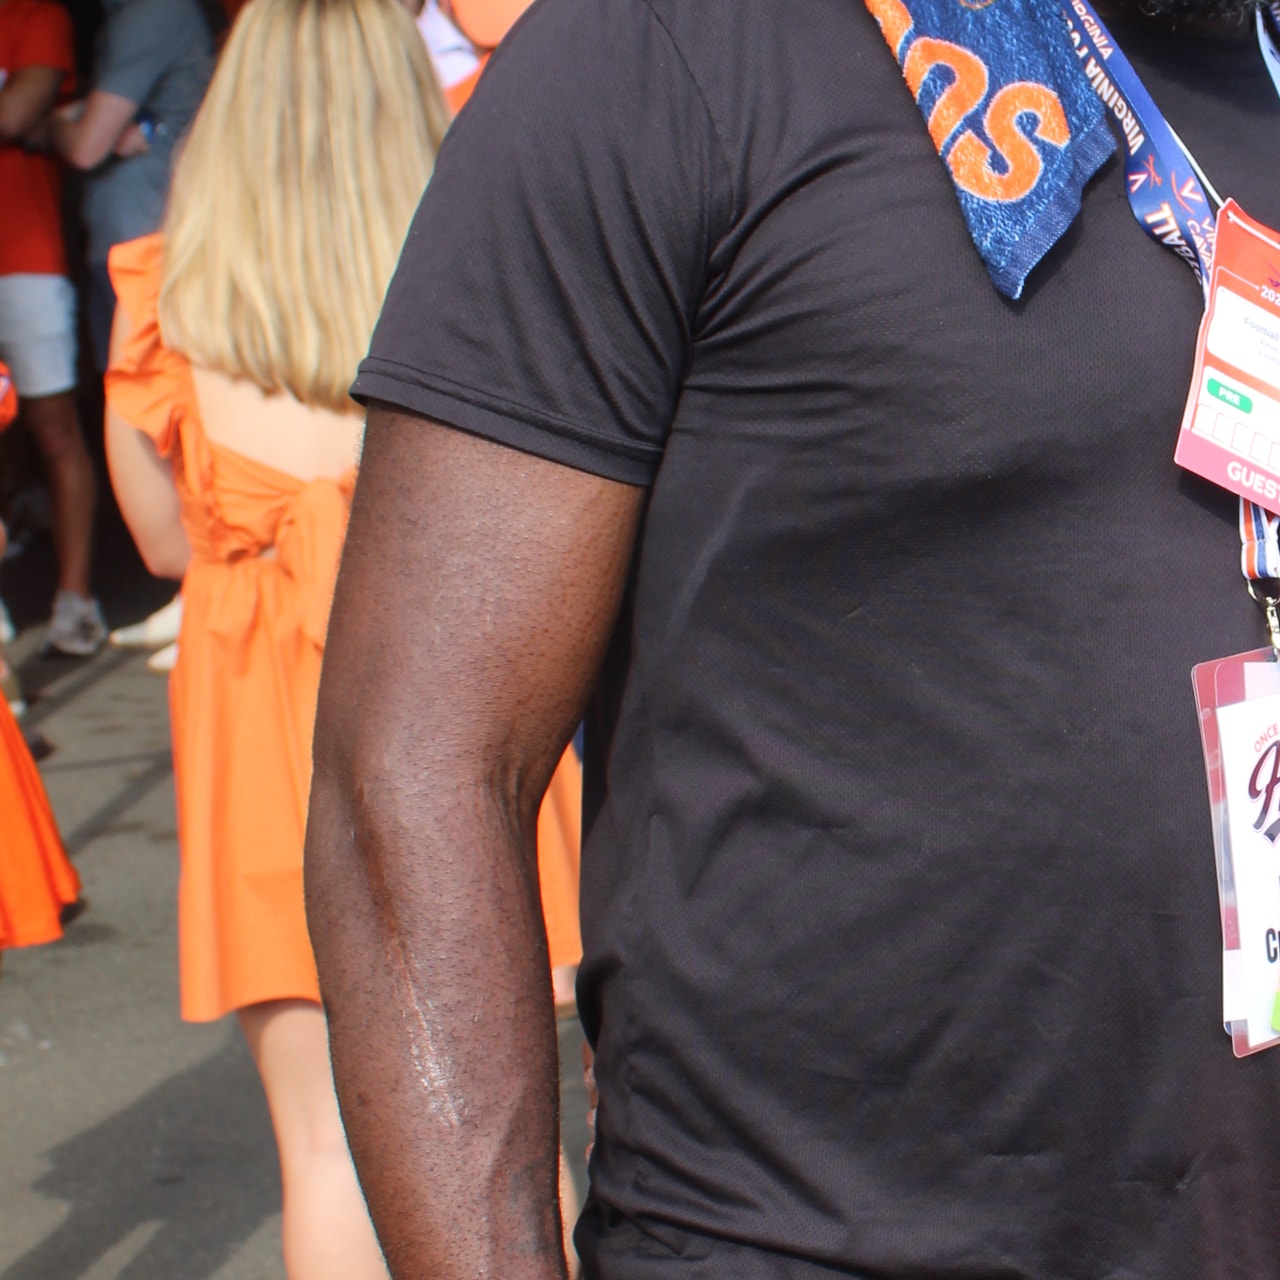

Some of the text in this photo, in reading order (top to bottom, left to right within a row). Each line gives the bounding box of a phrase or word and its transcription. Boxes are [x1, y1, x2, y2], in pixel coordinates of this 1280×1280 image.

[1084, 56, 1146, 156] VIRGINIA
[1244, 317, 1280, 341] Football
[1218, 386, 1241, 406] PRE
[1253, 723, 1279, 753] ONCE
